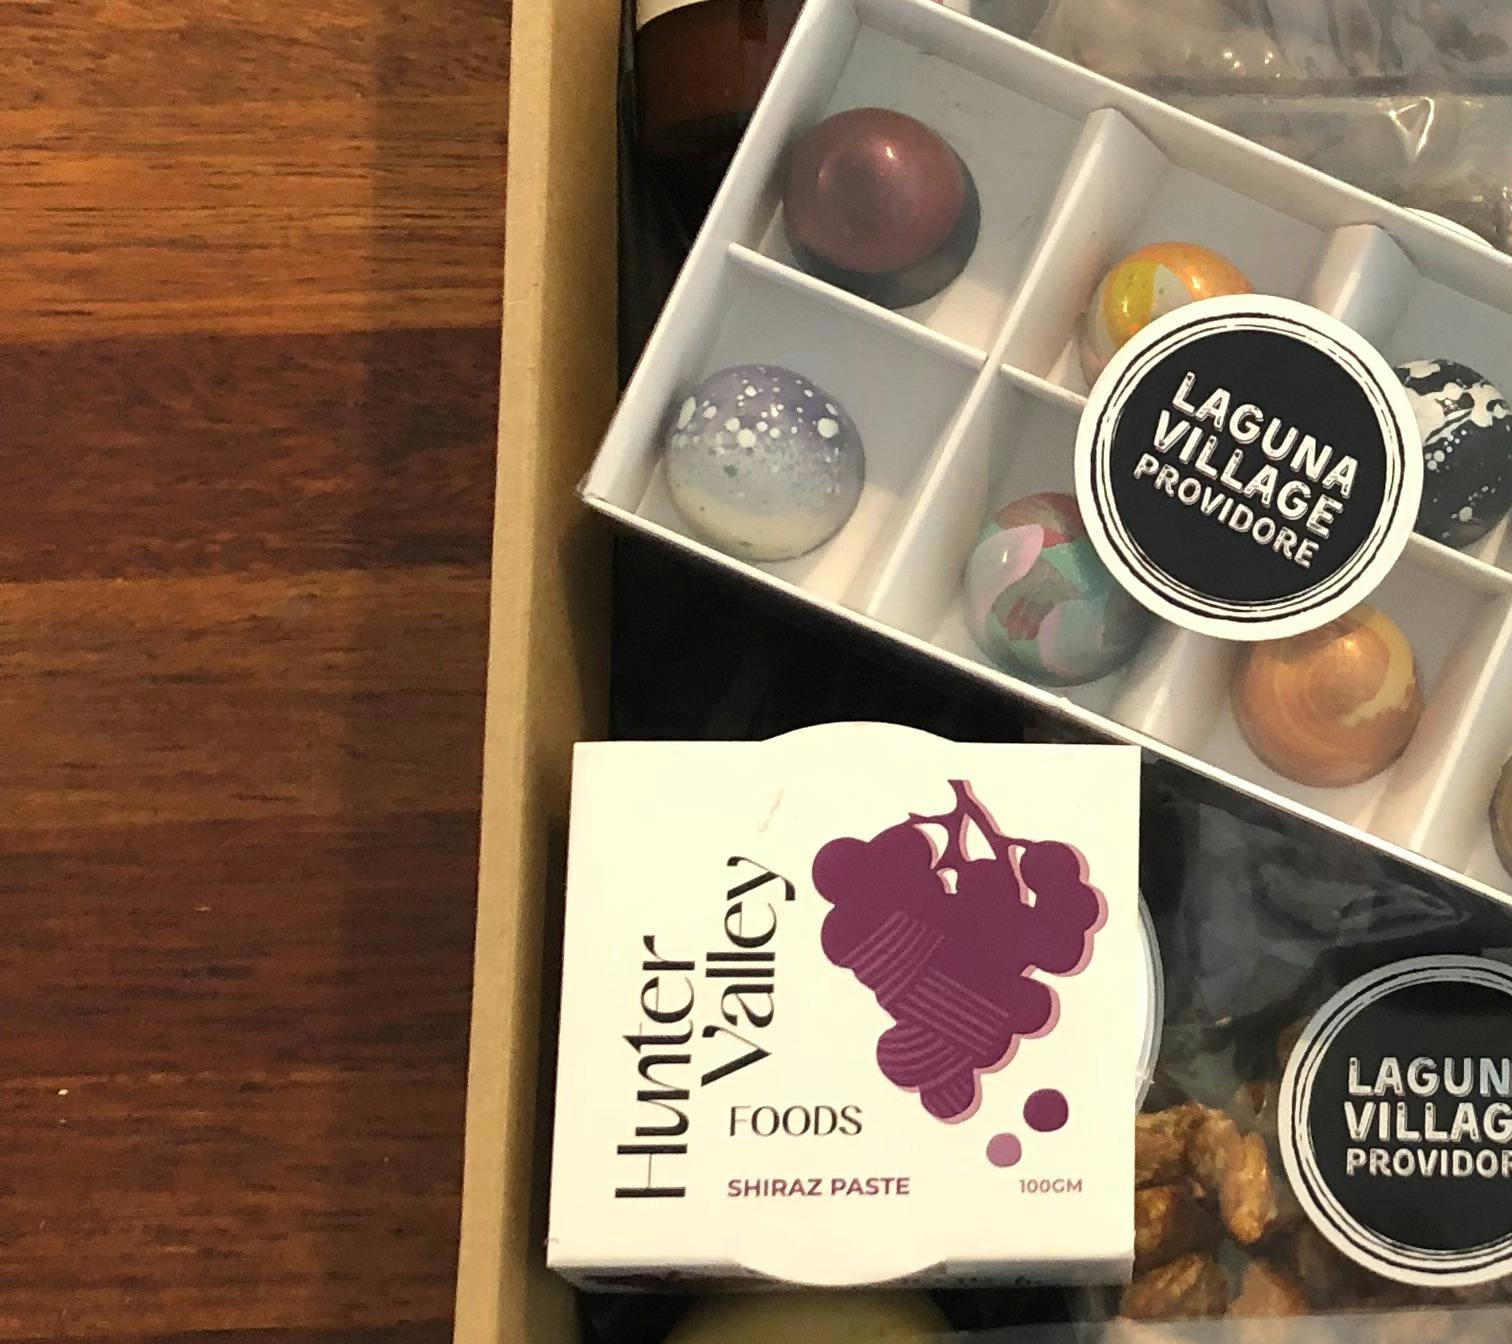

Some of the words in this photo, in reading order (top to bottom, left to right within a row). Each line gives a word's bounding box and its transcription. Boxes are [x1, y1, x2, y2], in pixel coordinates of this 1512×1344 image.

[1152, 409, 1344, 540] VILLAGE
[1171, 370, 1359, 500] LAGUNA
[1132, 452, 1320, 570] PROVIDORE
[699, 854, 797, 1089] Valley
[613, 933, 697, 1200] Hunter
[727, 1103, 864, 1139] FOODS
[726, 1176, 825, 1199] SHIRAZ
[830, 1175, 912, 1197] PASTE
[1018, 1177, 1084, 1195] 100GM
